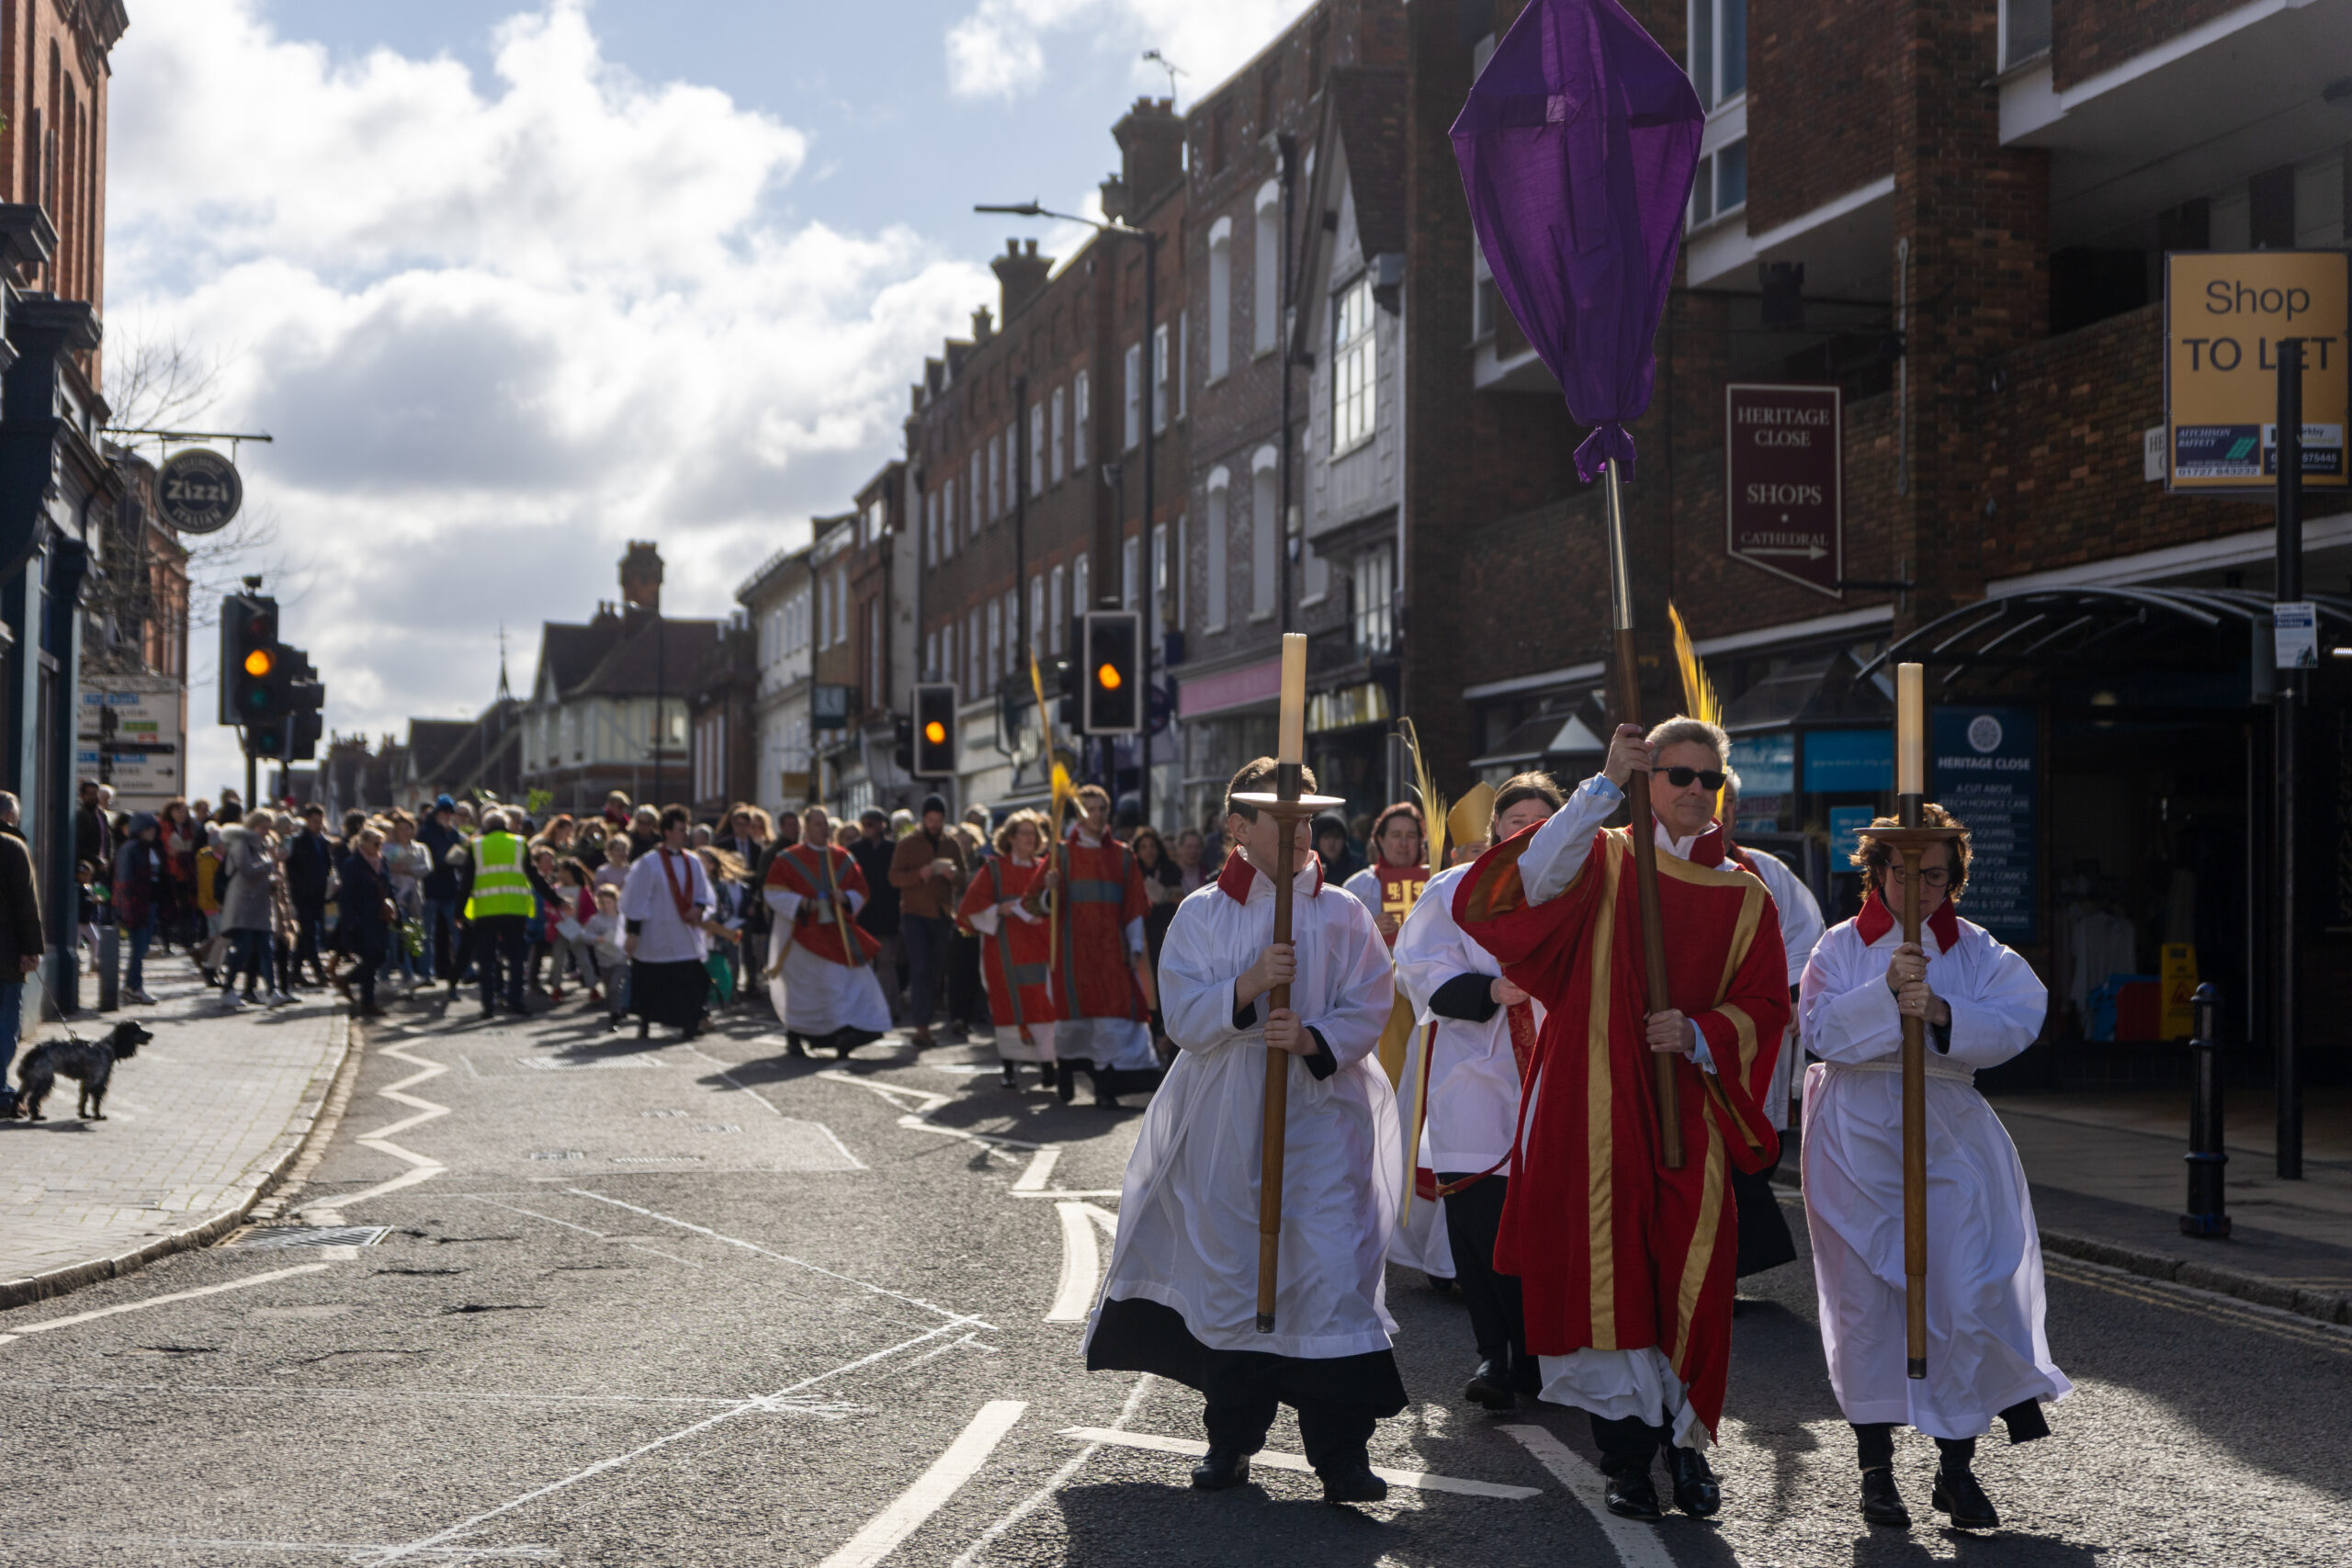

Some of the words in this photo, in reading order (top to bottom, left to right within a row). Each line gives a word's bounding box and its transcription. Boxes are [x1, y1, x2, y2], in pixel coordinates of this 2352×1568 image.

[2205, 279, 2310, 321] Shop
[2181, 337, 2243, 372] TO
[1738, 407, 1830, 425] HERITAGE
[1755, 429, 1811, 447] CLOSE
[2177, 468, 2211, 478] 01727
[166, 479, 229, 503] Zizzi
[1747, 483, 1823, 505] SHOPS
[1740, 532, 1828, 547] CATHEDRAL
[1938, 756, 1993, 770] HERITAGE
[1995, 757, 2031, 771] CLOSE
[1956, 784, 1962, 793] A
[1984, 784, 2014, 794] ABOVE
